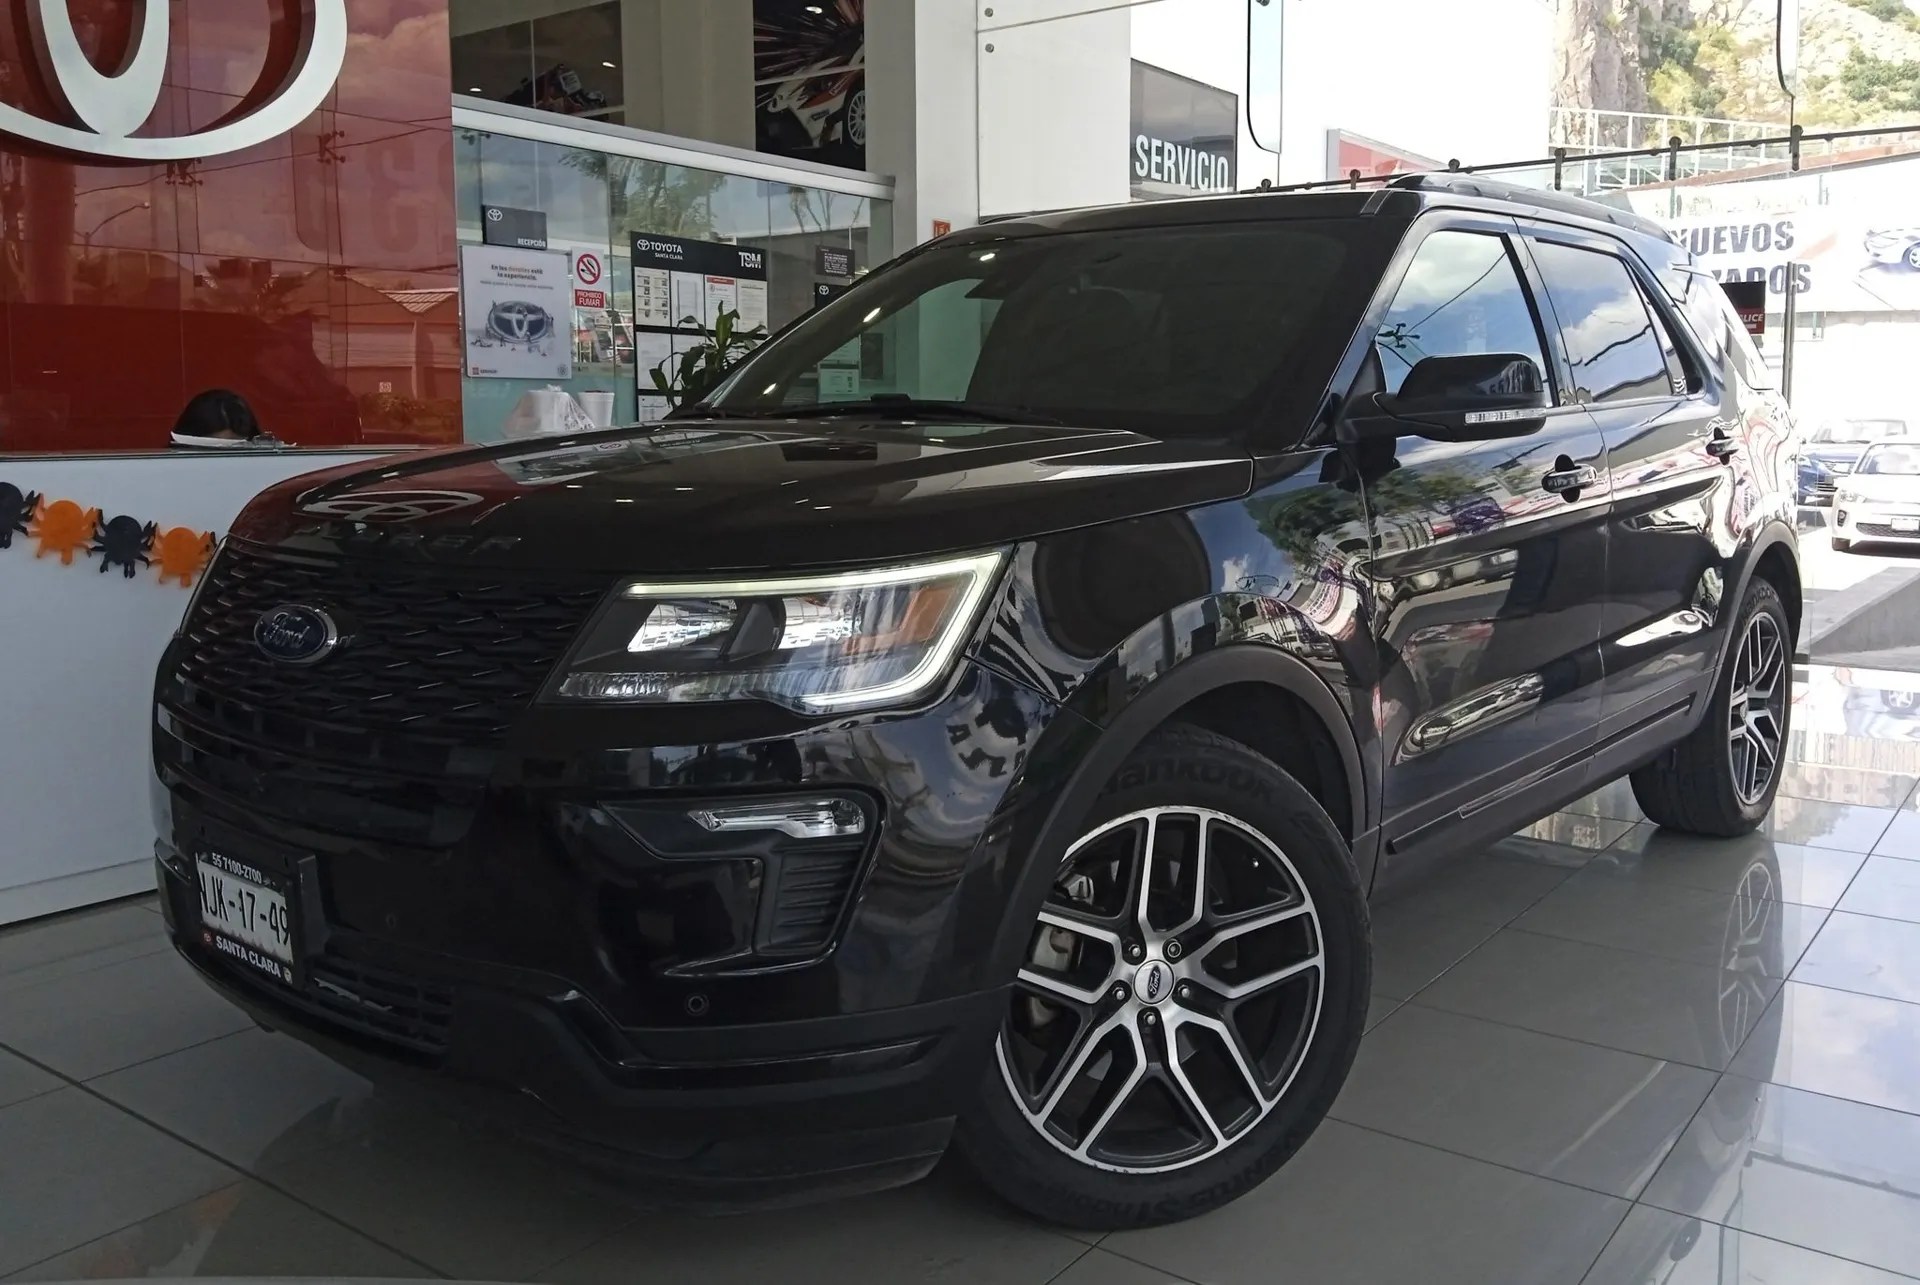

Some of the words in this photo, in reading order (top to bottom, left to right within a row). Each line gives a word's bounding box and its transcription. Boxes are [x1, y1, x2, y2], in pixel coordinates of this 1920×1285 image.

[1135, 134, 1229, 192] SERVICIO
[650, 241, 683, 253] TOYOTA
[655, 252, 669, 260] SANTA
[738, 251, 762, 269] TSM
[579, 298, 600, 308] FUMAR
[211, 852, 223, 868] 55
[222, 857, 263, 884] 7100-2700
[215, 935, 248, 962] SANTA
[248, 952, 282, 978] CLARA
